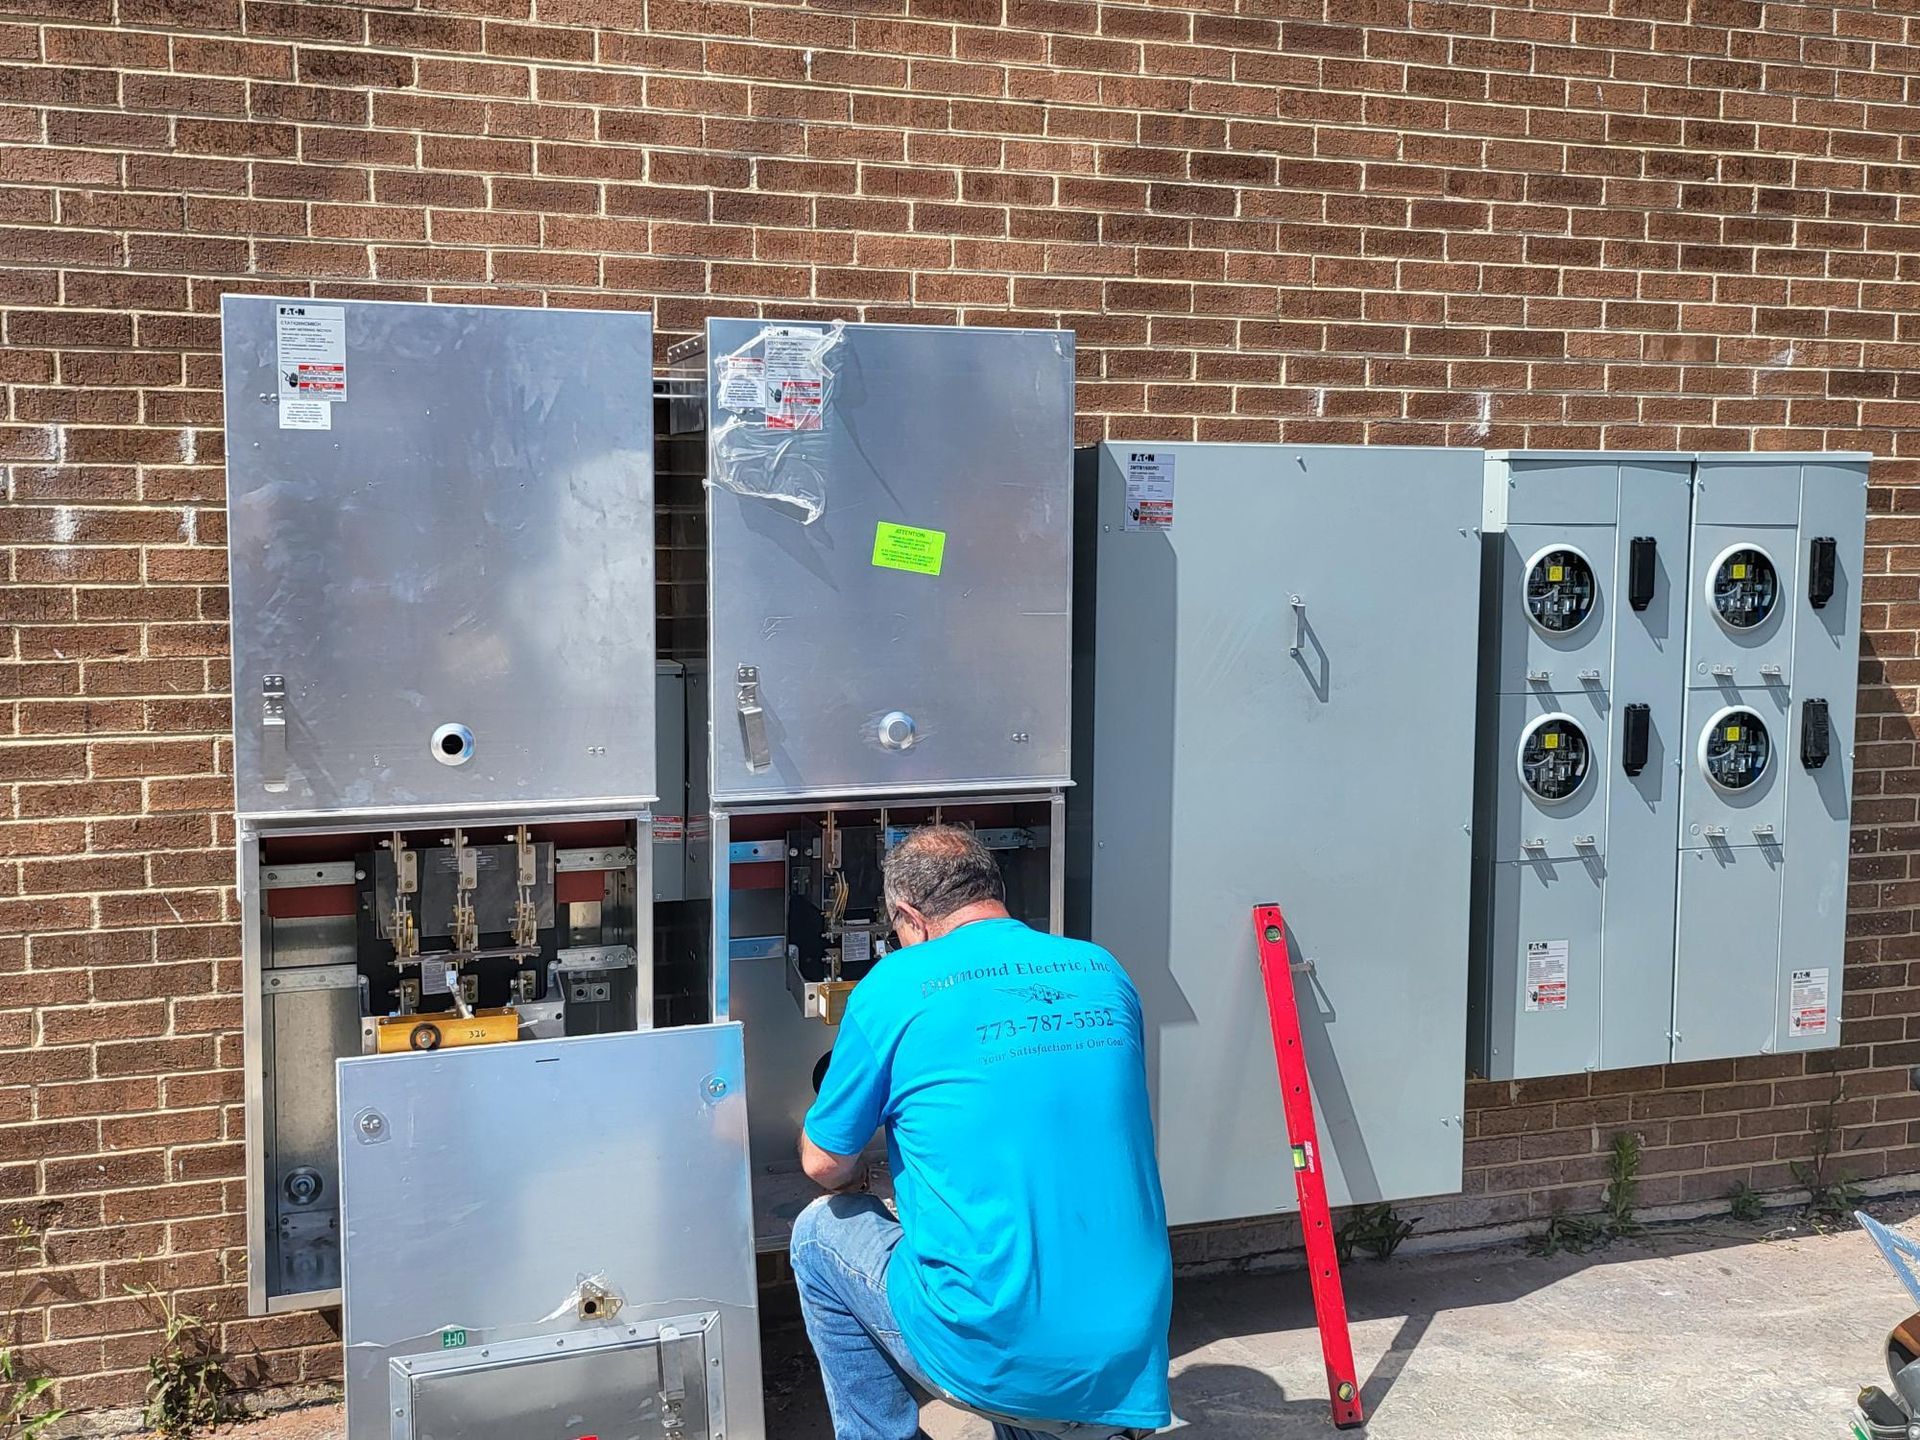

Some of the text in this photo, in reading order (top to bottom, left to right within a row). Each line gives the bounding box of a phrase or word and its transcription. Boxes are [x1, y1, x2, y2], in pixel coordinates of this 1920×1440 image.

[921, 963, 1009, 999] Diamond
[1016, 960, 1087, 975] Electric,
[469, 1030, 486, 1038] 326
[976, 1008, 1114, 1043] 773-787-5552
[1009, 1042, 1072, 1058] Satisfaction
[1075, 1041, 1084, 1050] is
[1087, 1038, 1104, 1049] Our
[445, 1332, 464, 1347] OFF
